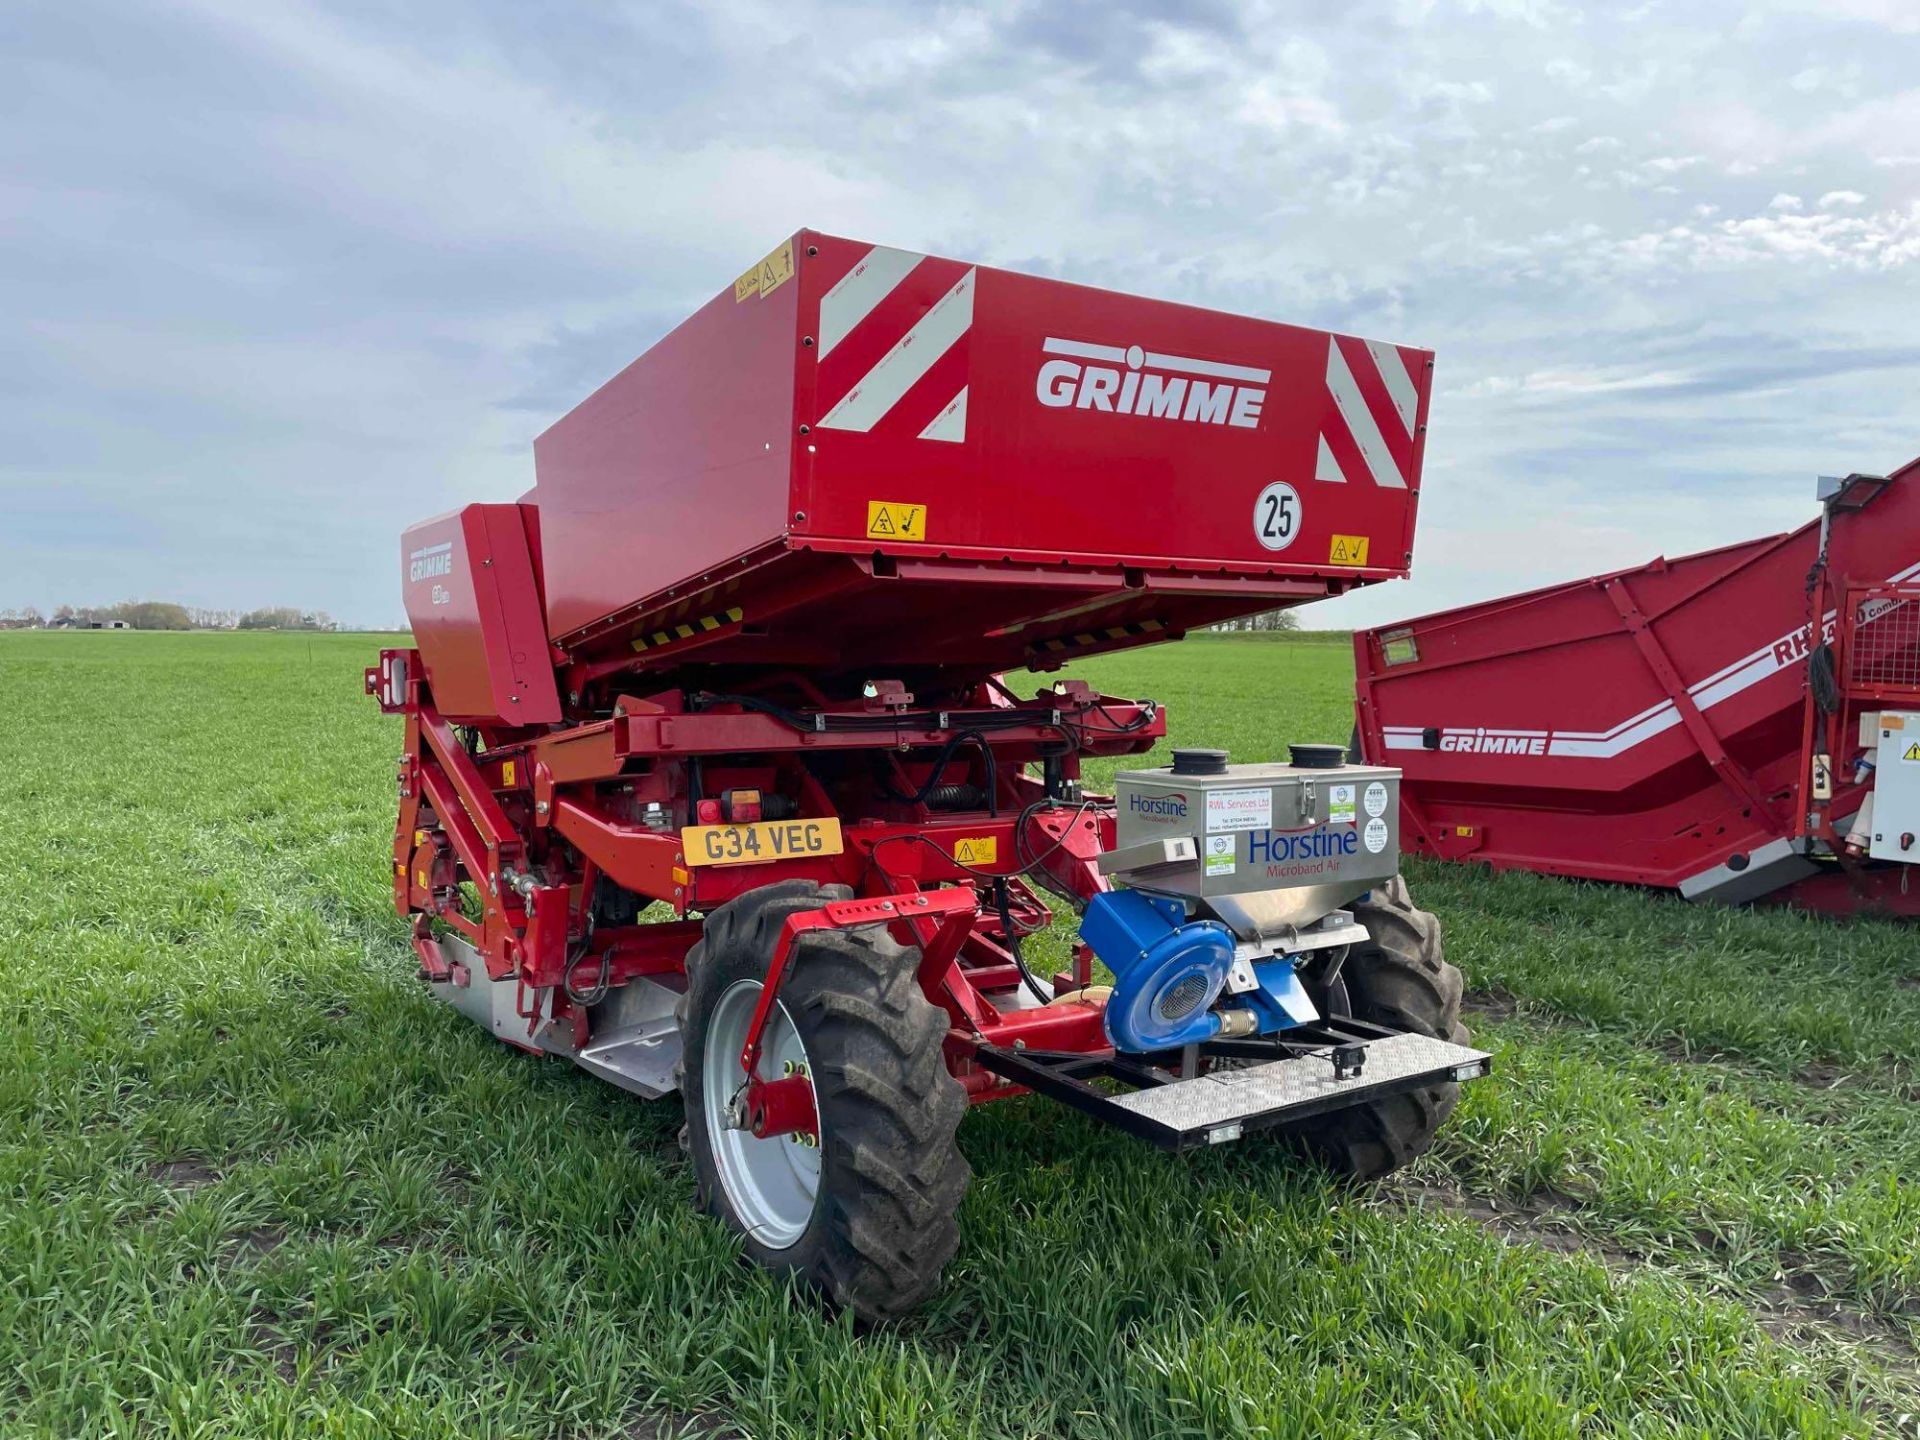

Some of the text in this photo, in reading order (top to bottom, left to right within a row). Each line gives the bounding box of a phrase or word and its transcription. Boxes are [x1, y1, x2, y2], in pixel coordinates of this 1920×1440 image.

[1036, 345, 1268, 428] GRIMME
[1263, 494, 1293, 537] 25
[410, 547, 452, 582] GRIMME
[1439, 727, 1547, 755] GRIMME
[1130, 794, 1187, 817] Horstine
[1208, 798, 1270, 810] RWL Services Ltd
[705, 824, 823, 859] G34 VEG
[1249, 826, 1358, 863] Horstine
[1267, 860, 1340, 877] Microband Air
